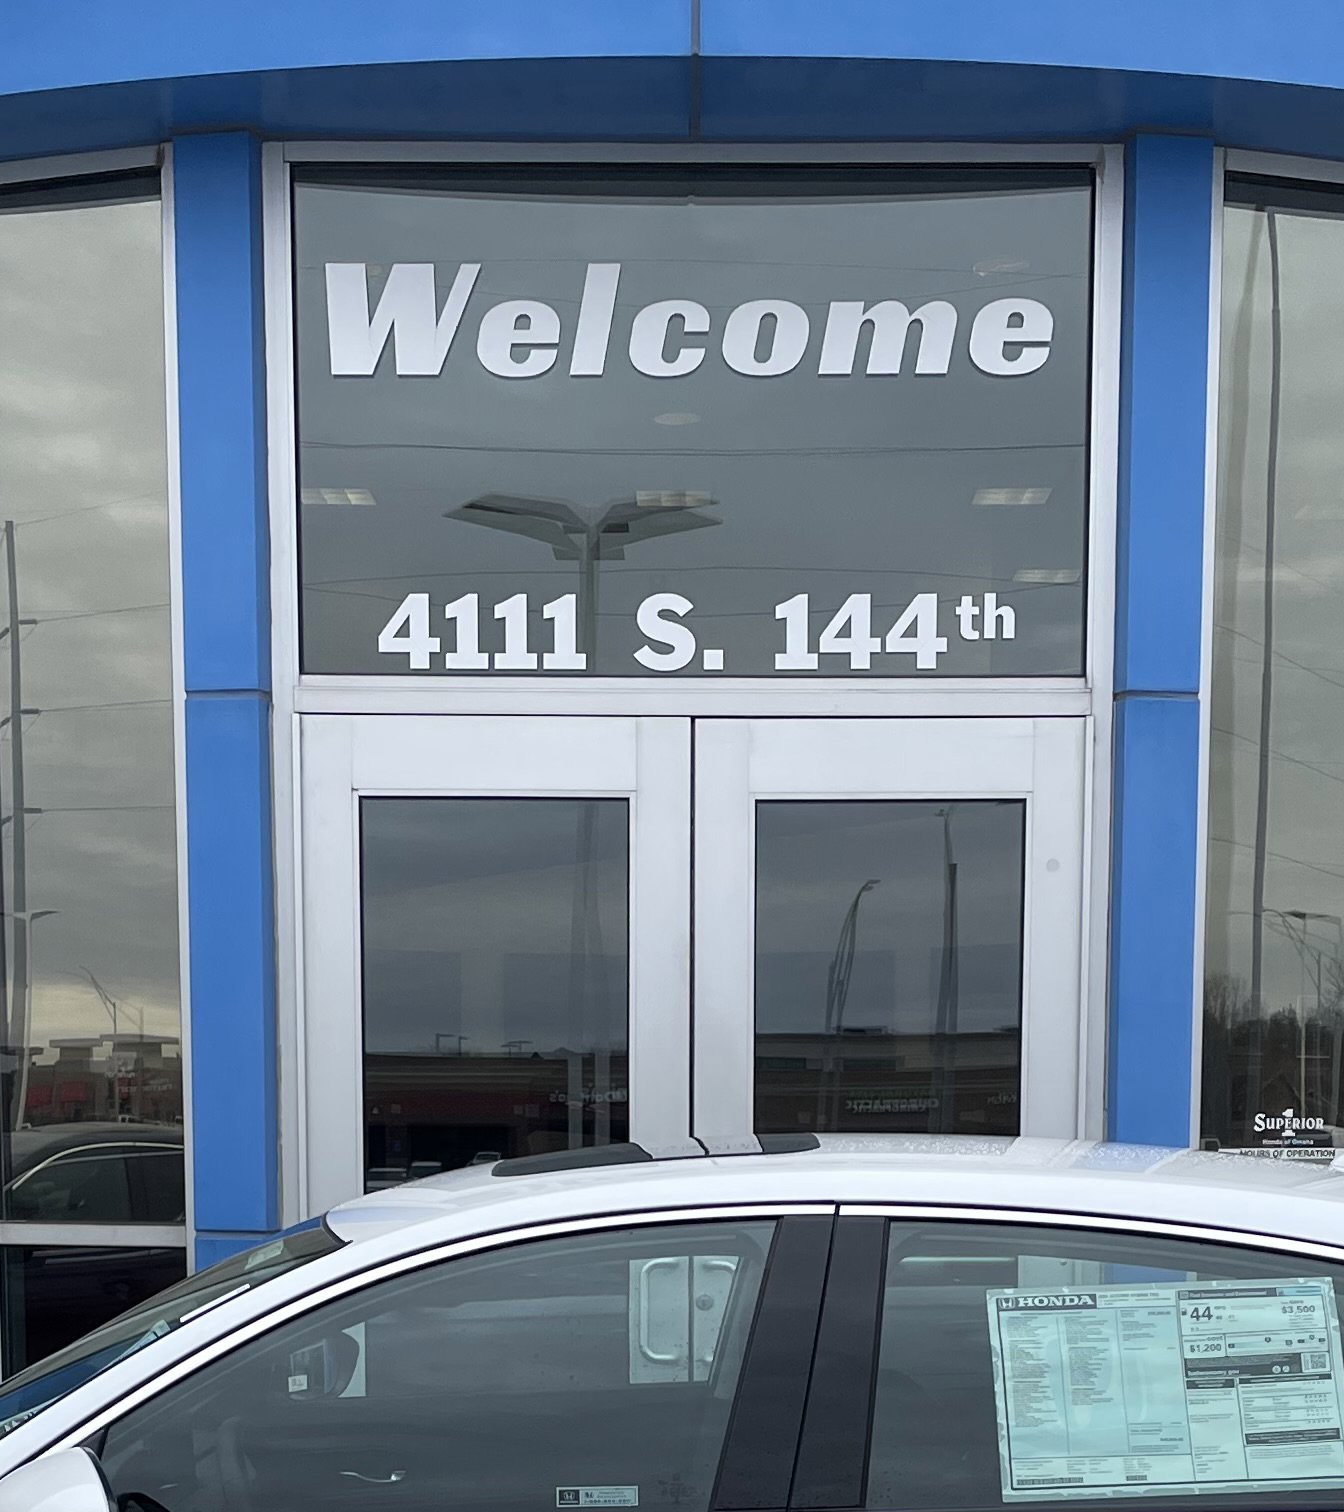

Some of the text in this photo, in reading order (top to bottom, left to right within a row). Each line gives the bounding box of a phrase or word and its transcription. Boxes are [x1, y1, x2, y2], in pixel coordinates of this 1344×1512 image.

[325, 262, 1055, 378] Welcome
[378, 592, 1016, 671] 4111 S. 144th
[1272, 1149, 1285, 1158] OF
[1286, 1149, 1335, 1158] OPERATION
[1017, 1295, 1095, 1307] HONDA
[1190, 1306, 1213, 1321] 44
